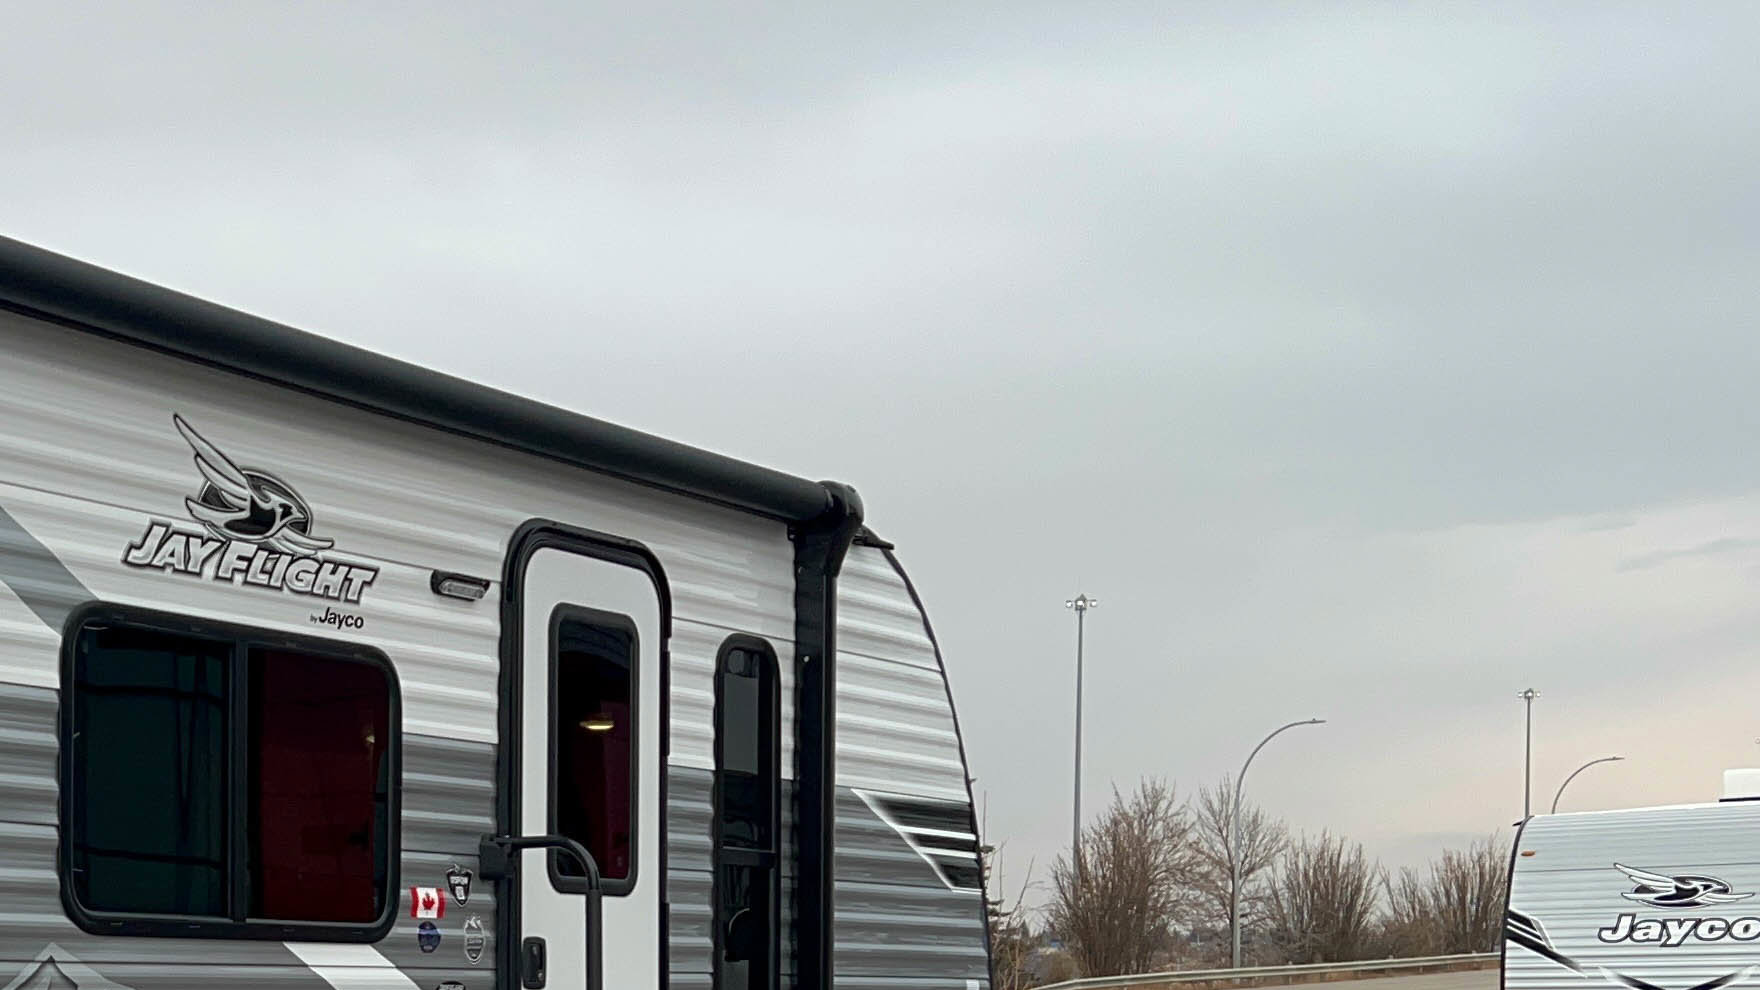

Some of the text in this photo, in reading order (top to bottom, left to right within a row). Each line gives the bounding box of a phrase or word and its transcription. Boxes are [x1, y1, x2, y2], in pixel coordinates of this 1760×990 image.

[122, 519, 379, 604] JAY FLIGHT
[319, 608, 364, 629] Jayco
[1598, 913, 1760, 947] Jayco
